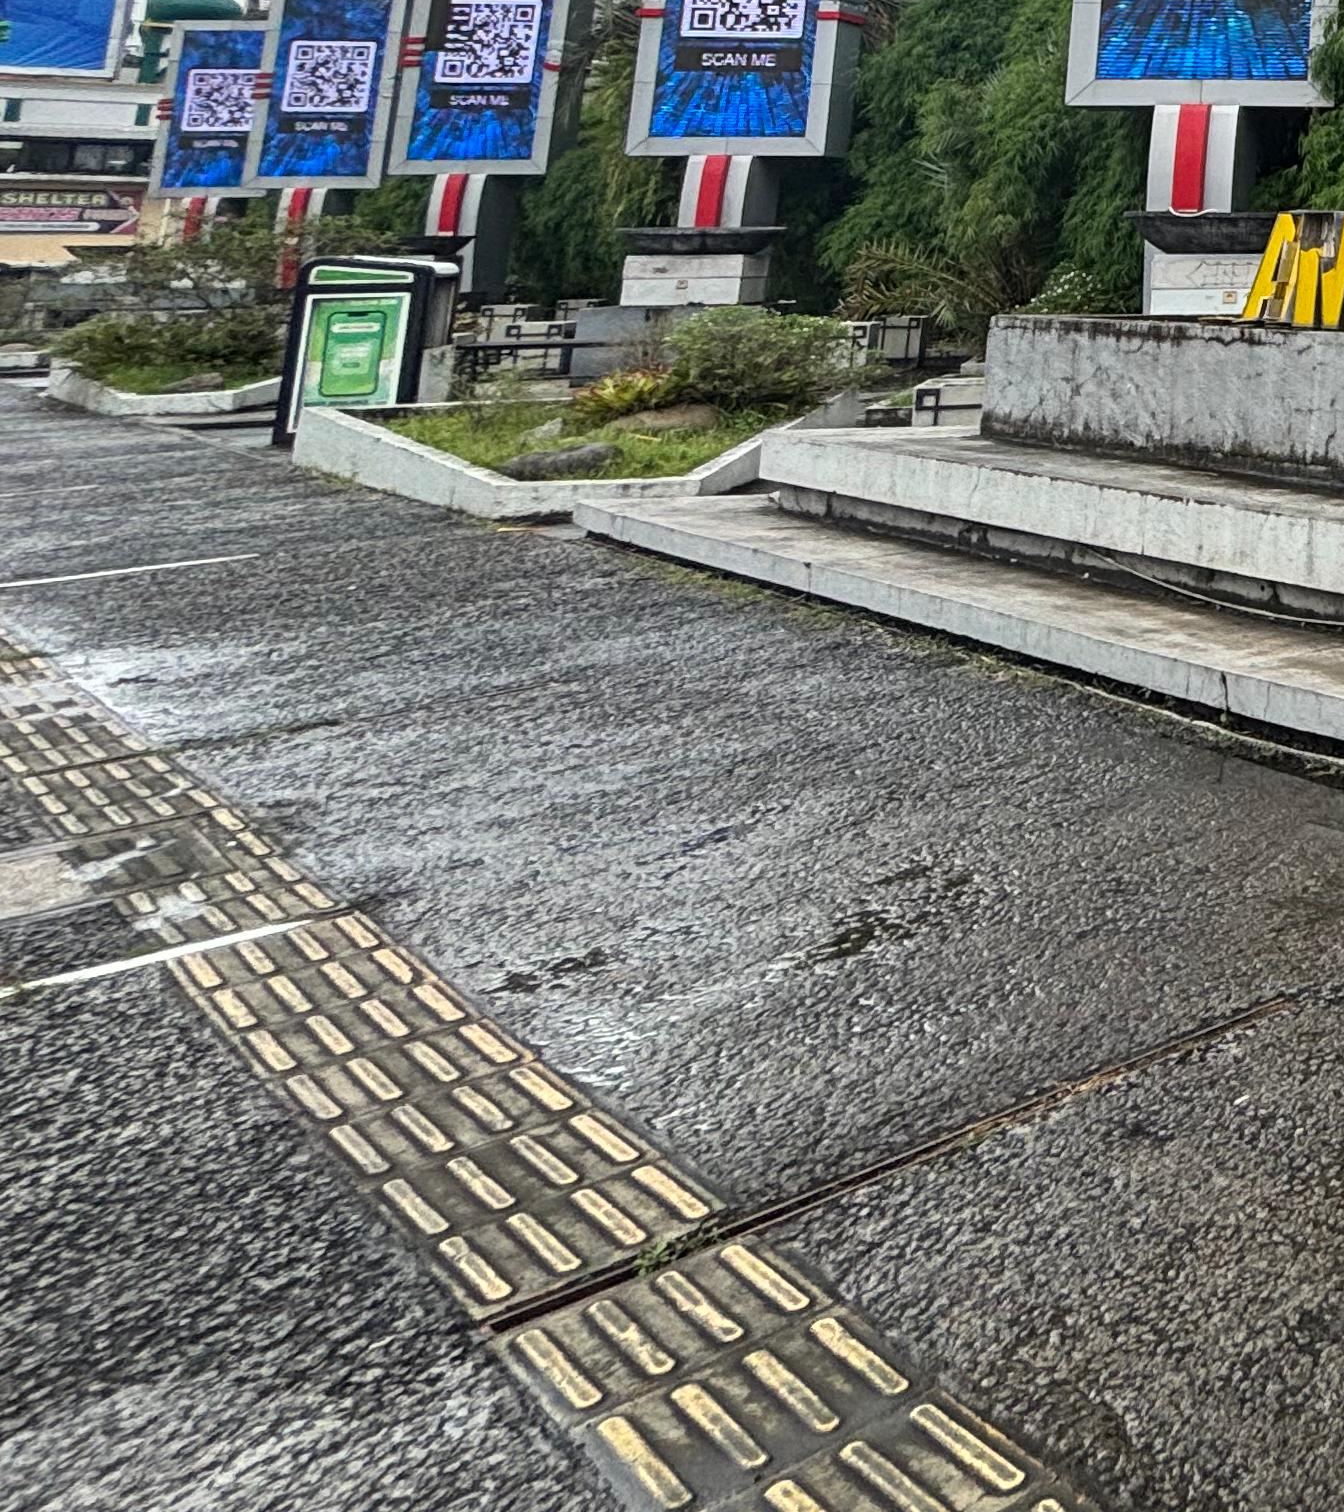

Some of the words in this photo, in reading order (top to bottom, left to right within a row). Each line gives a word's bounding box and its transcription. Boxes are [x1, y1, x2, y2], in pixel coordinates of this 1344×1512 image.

[702, 52, 748, 67] SCAN
[751, 53, 777, 67] ME
[448, 94, 488, 106] SCAN
[1, 192, 107, 205] SHELTER
